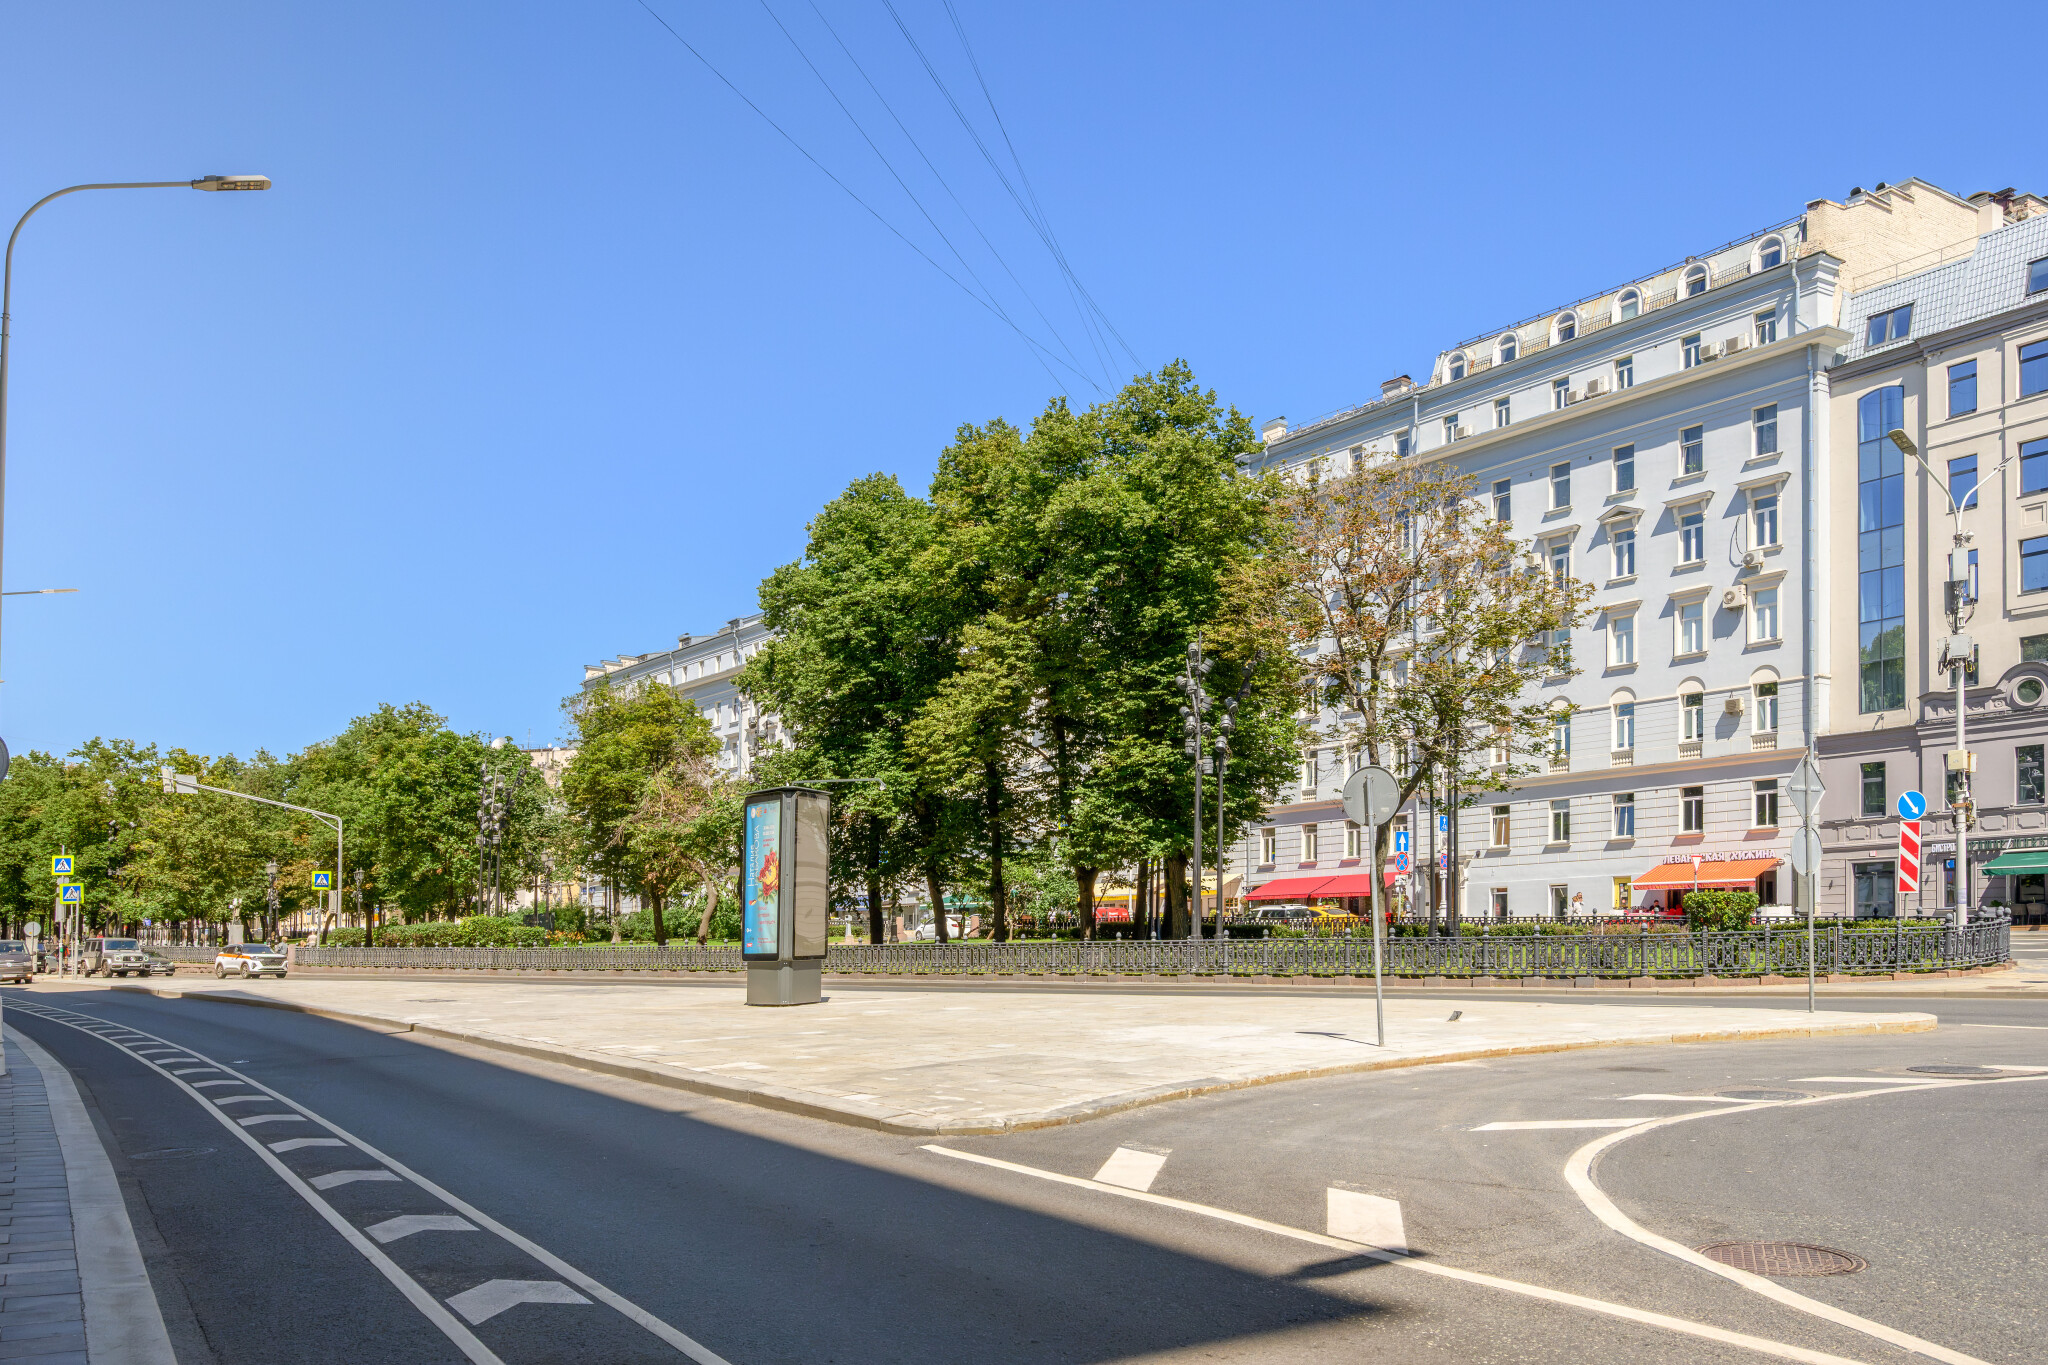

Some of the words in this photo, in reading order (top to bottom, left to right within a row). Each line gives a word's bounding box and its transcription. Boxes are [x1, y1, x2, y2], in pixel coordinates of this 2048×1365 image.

[1931, 842, 1956, 852] БИСТРО
[1662, 852, 1725, 865] ЛЕВАНСКАЯ
[1730, 849, 1776, 861] ХИЖИНА
